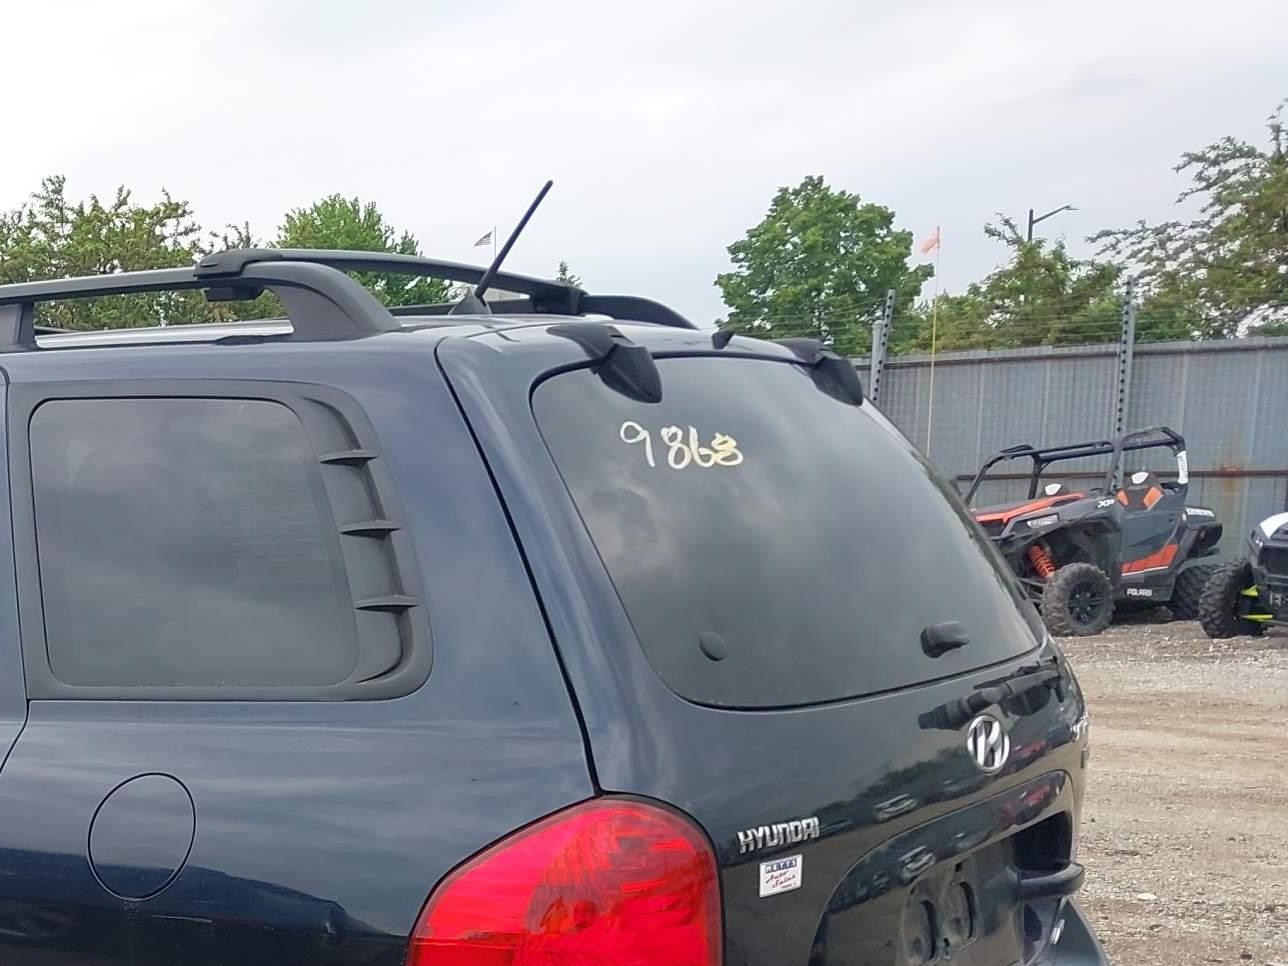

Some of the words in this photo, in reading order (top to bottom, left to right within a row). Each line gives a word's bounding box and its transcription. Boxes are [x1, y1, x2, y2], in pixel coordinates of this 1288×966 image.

[620, 421, 744, 470] 9868
[1126, 588, 1153, 597] POLARIS
[737, 816, 820, 855] HYUNDAI
